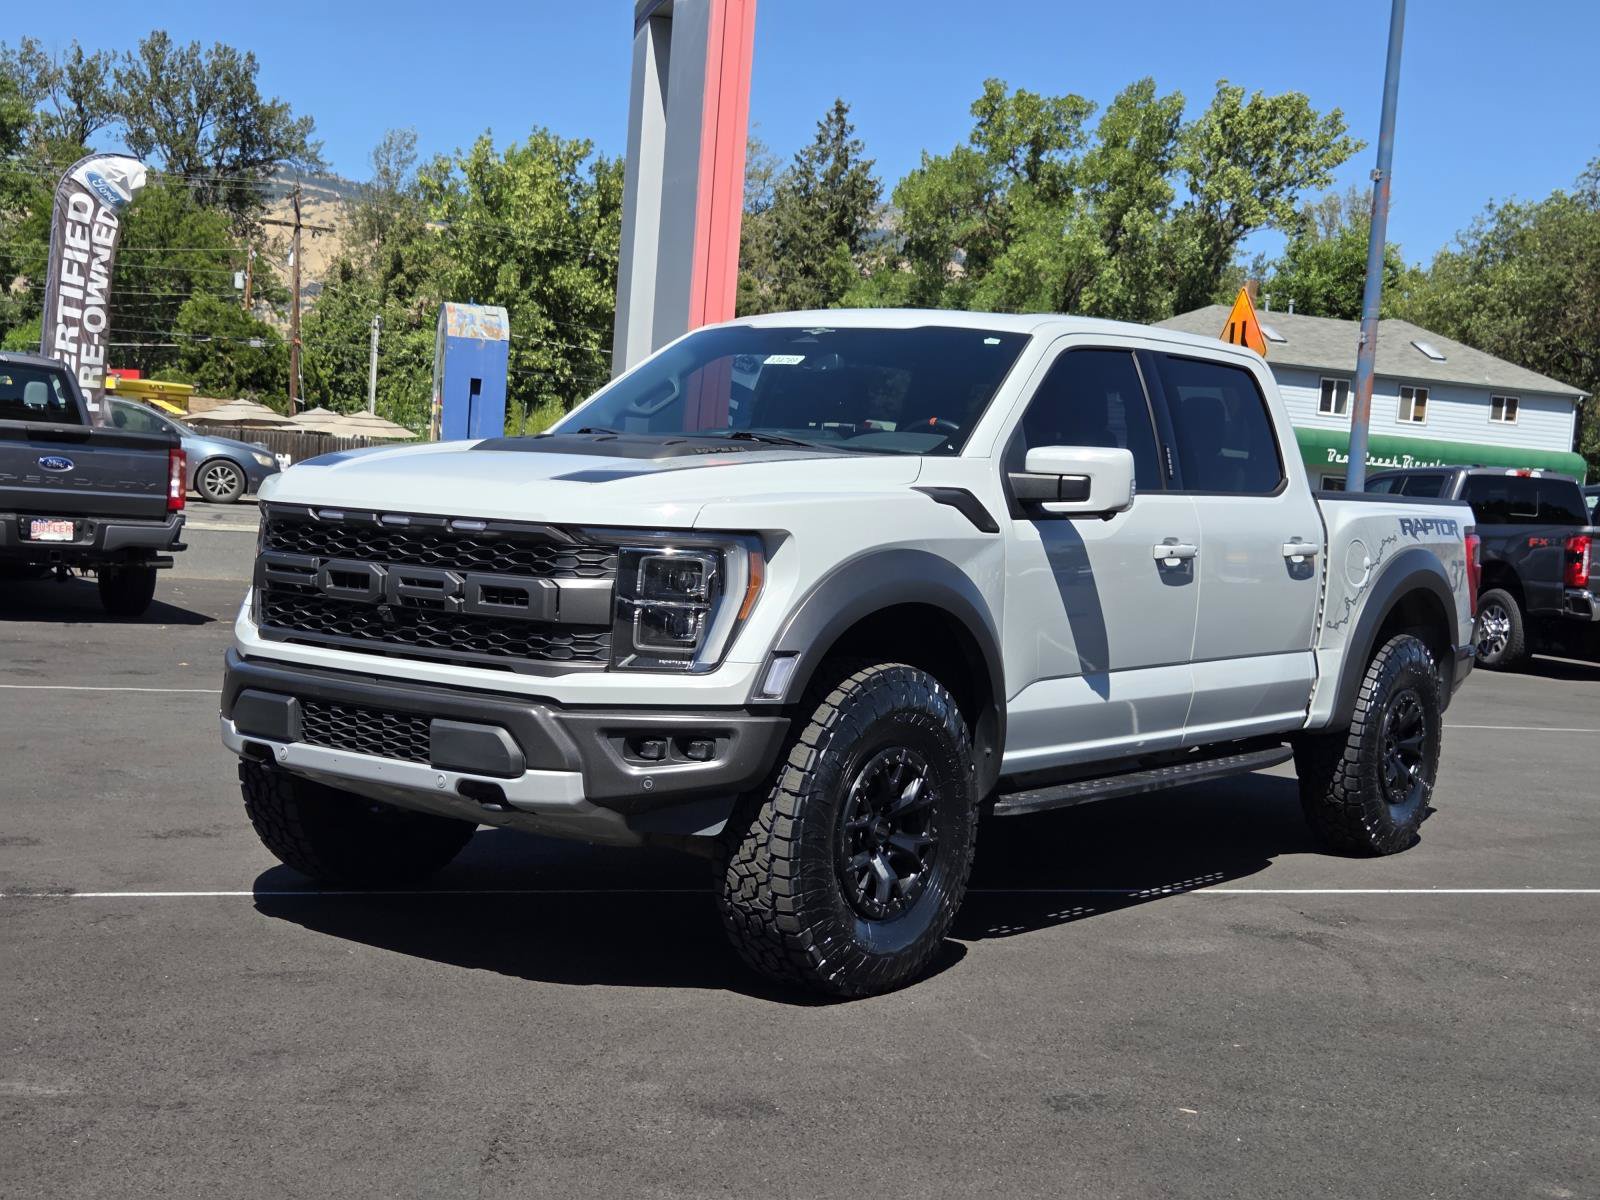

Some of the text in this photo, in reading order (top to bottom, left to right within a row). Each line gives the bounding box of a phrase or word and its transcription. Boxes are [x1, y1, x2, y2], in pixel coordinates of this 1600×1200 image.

[91, 178, 119, 204] Ford
[1327, 448, 1349, 464] Bea
[1365, 452, 1402, 468] reek
[32, 521, 73, 534] BUTLER
[1398, 518, 1463, 543] RAPTOR
